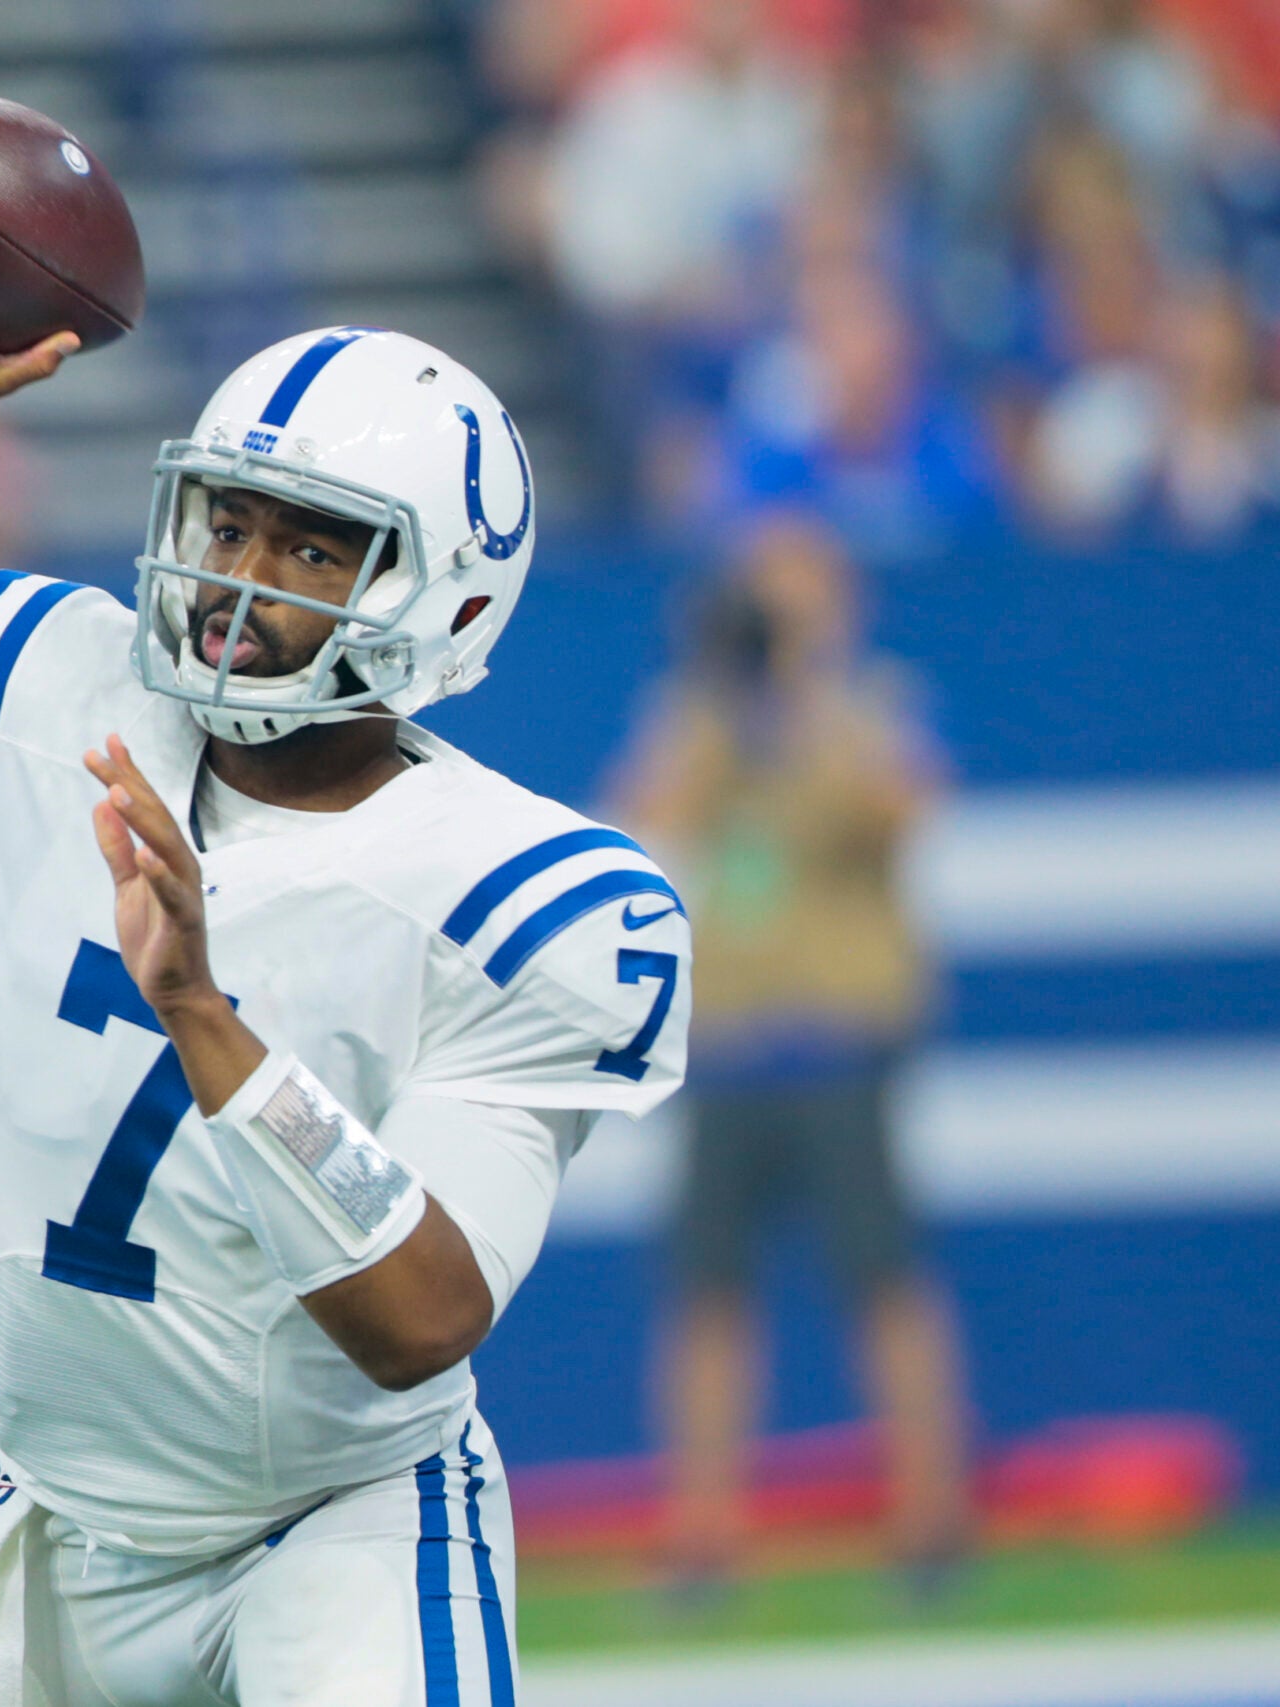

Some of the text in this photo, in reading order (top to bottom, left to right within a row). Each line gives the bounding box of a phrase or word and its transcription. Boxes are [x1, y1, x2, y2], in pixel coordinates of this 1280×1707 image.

[242, 430, 278, 454] COLTS
[593, 948, 678, 1082] 7
[42, 938, 239, 1302] 7
